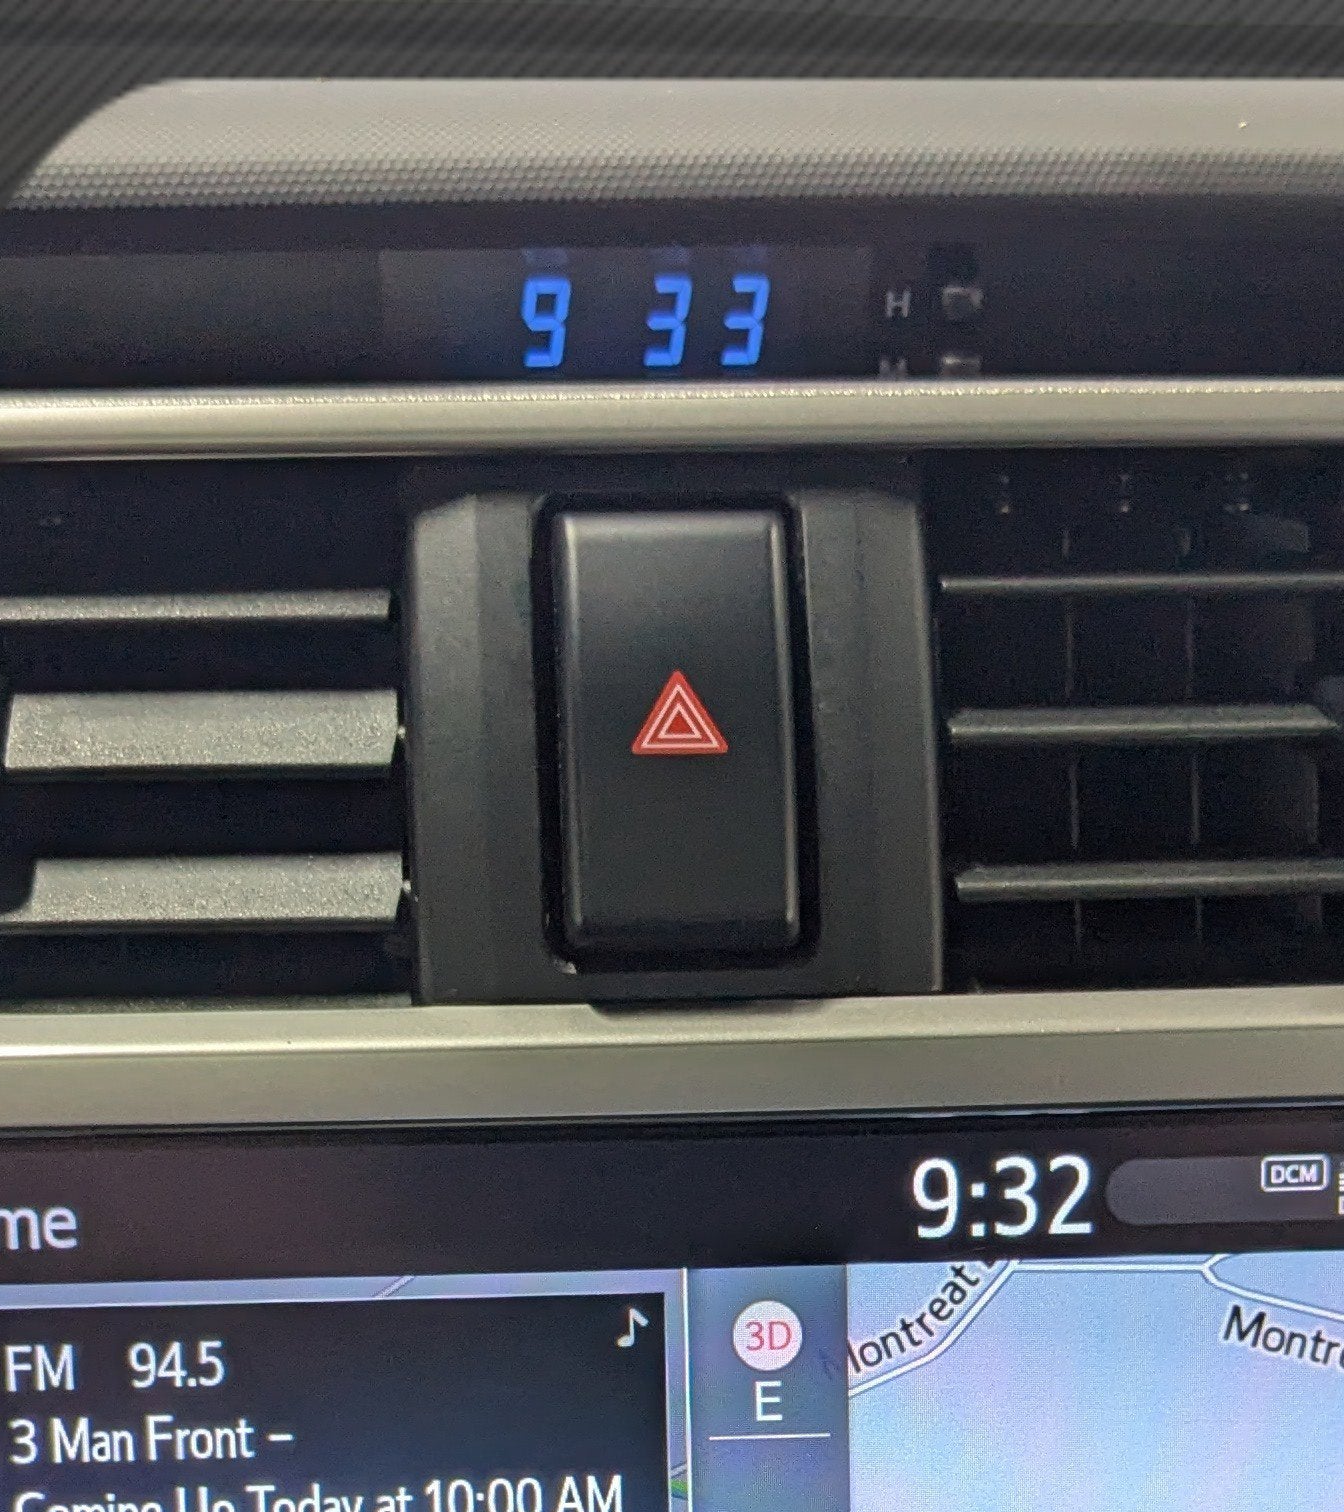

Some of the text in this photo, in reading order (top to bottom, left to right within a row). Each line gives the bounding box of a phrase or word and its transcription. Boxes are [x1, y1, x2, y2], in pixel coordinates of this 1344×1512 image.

[885, 289, 911, 318] H
[1269, 1164, 1319, 1184] DCM
[910, 1153, 1095, 1241] 9:32
[745, 1320, 794, 1353] 3D
[5, 1340, 226, 1393] FM 94.5
[755, 1380, 784, 1423] E
[8, 1419, 38, 1465] 3
[52, 1416, 135, 1464] Man
[146, 1413, 255, 1462] Front
